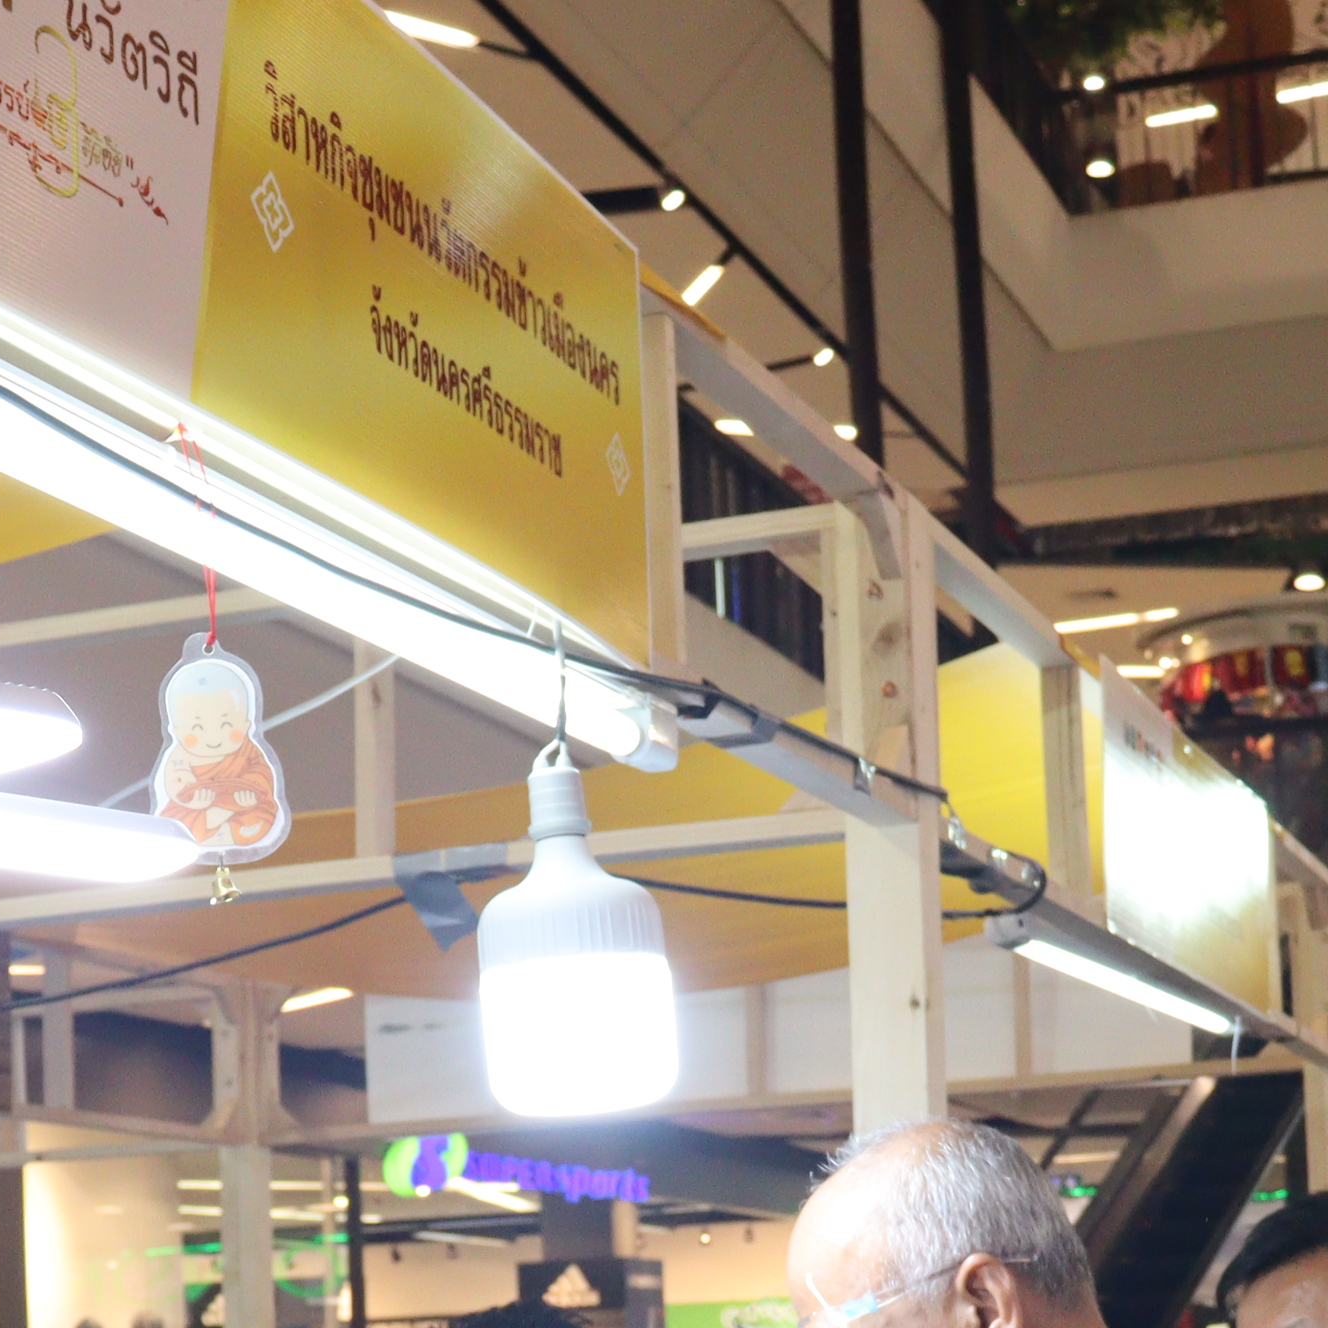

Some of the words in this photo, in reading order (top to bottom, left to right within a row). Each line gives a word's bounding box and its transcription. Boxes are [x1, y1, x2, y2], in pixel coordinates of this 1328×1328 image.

[370, 284, 564, 479] จังหวัดนครศรีธรรมราช
